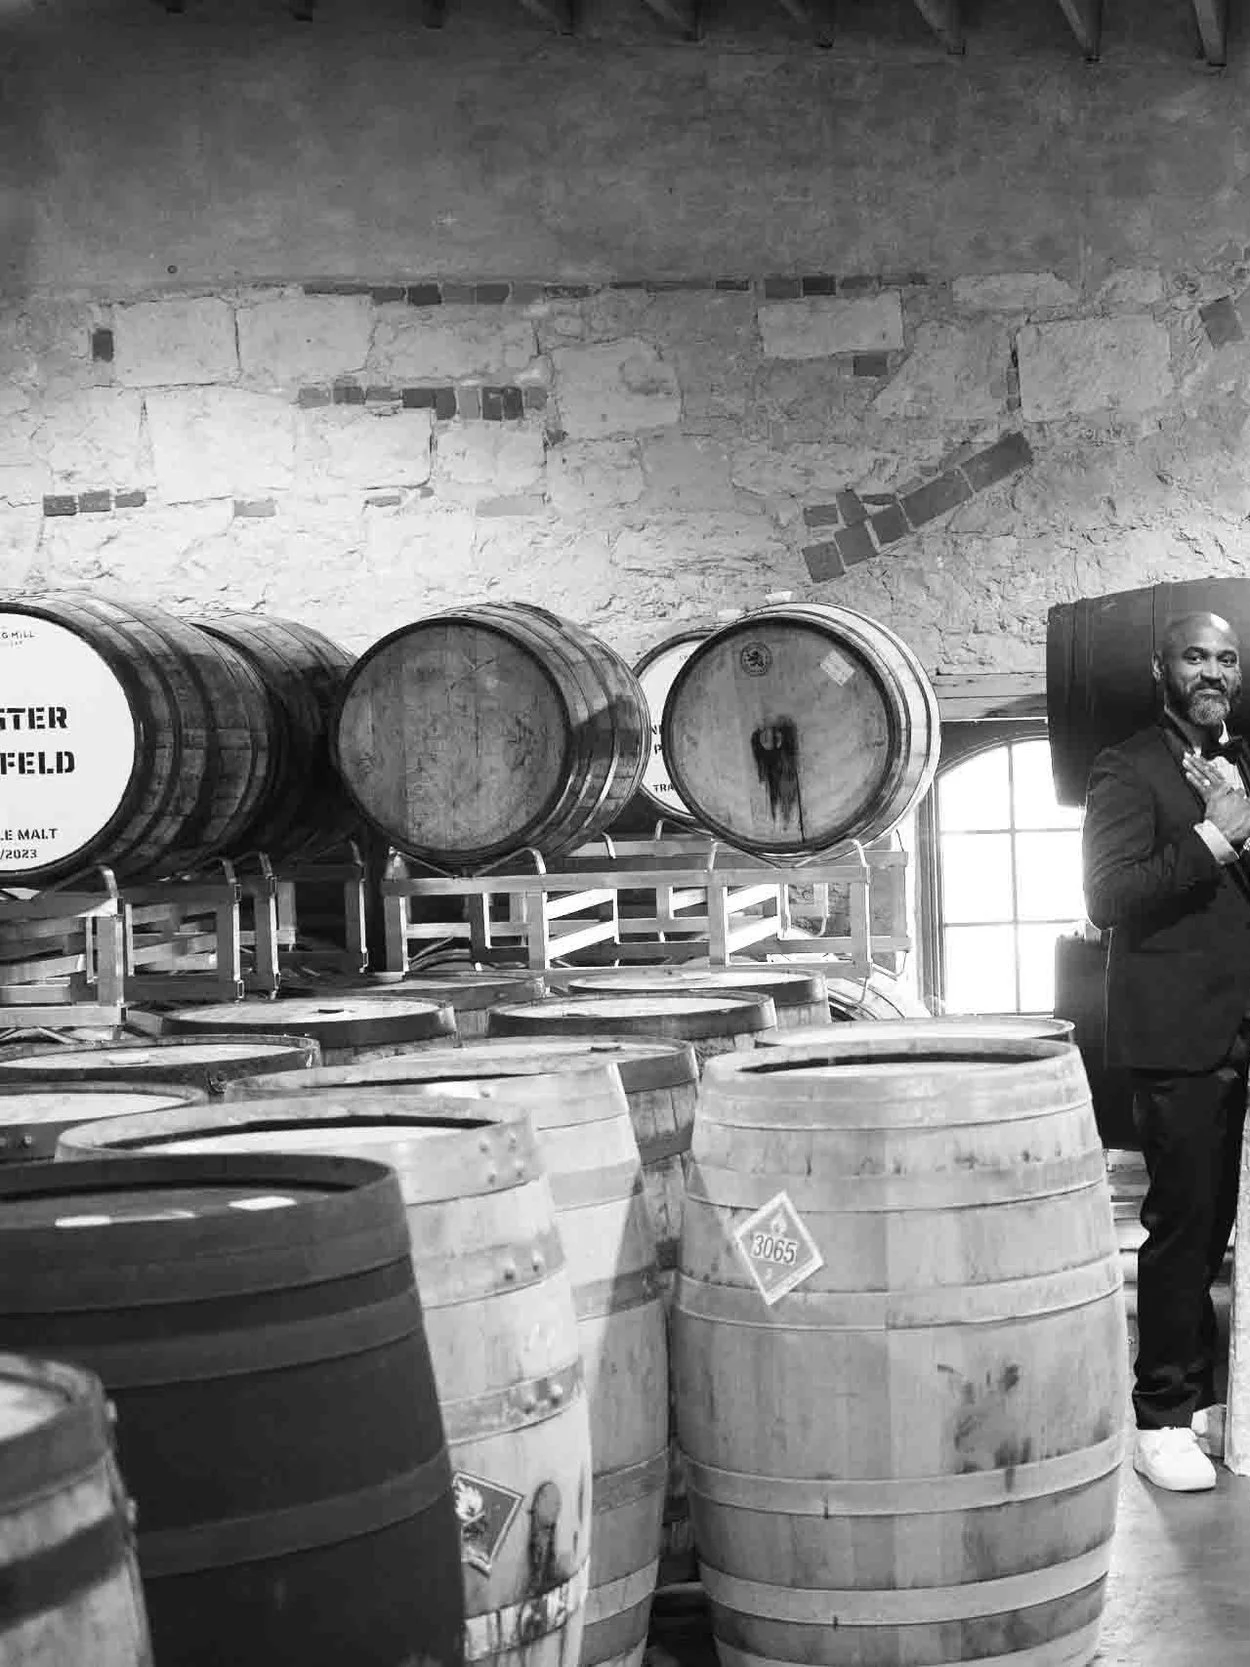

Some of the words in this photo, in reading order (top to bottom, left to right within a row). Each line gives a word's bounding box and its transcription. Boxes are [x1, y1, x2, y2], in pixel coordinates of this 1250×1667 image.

[11, 630, 36, 639] MILL
[652, 783, 675, 792] TRA
[17, 828, 59, 840] MALT
[753, 1234, 797, 1264] 3065
